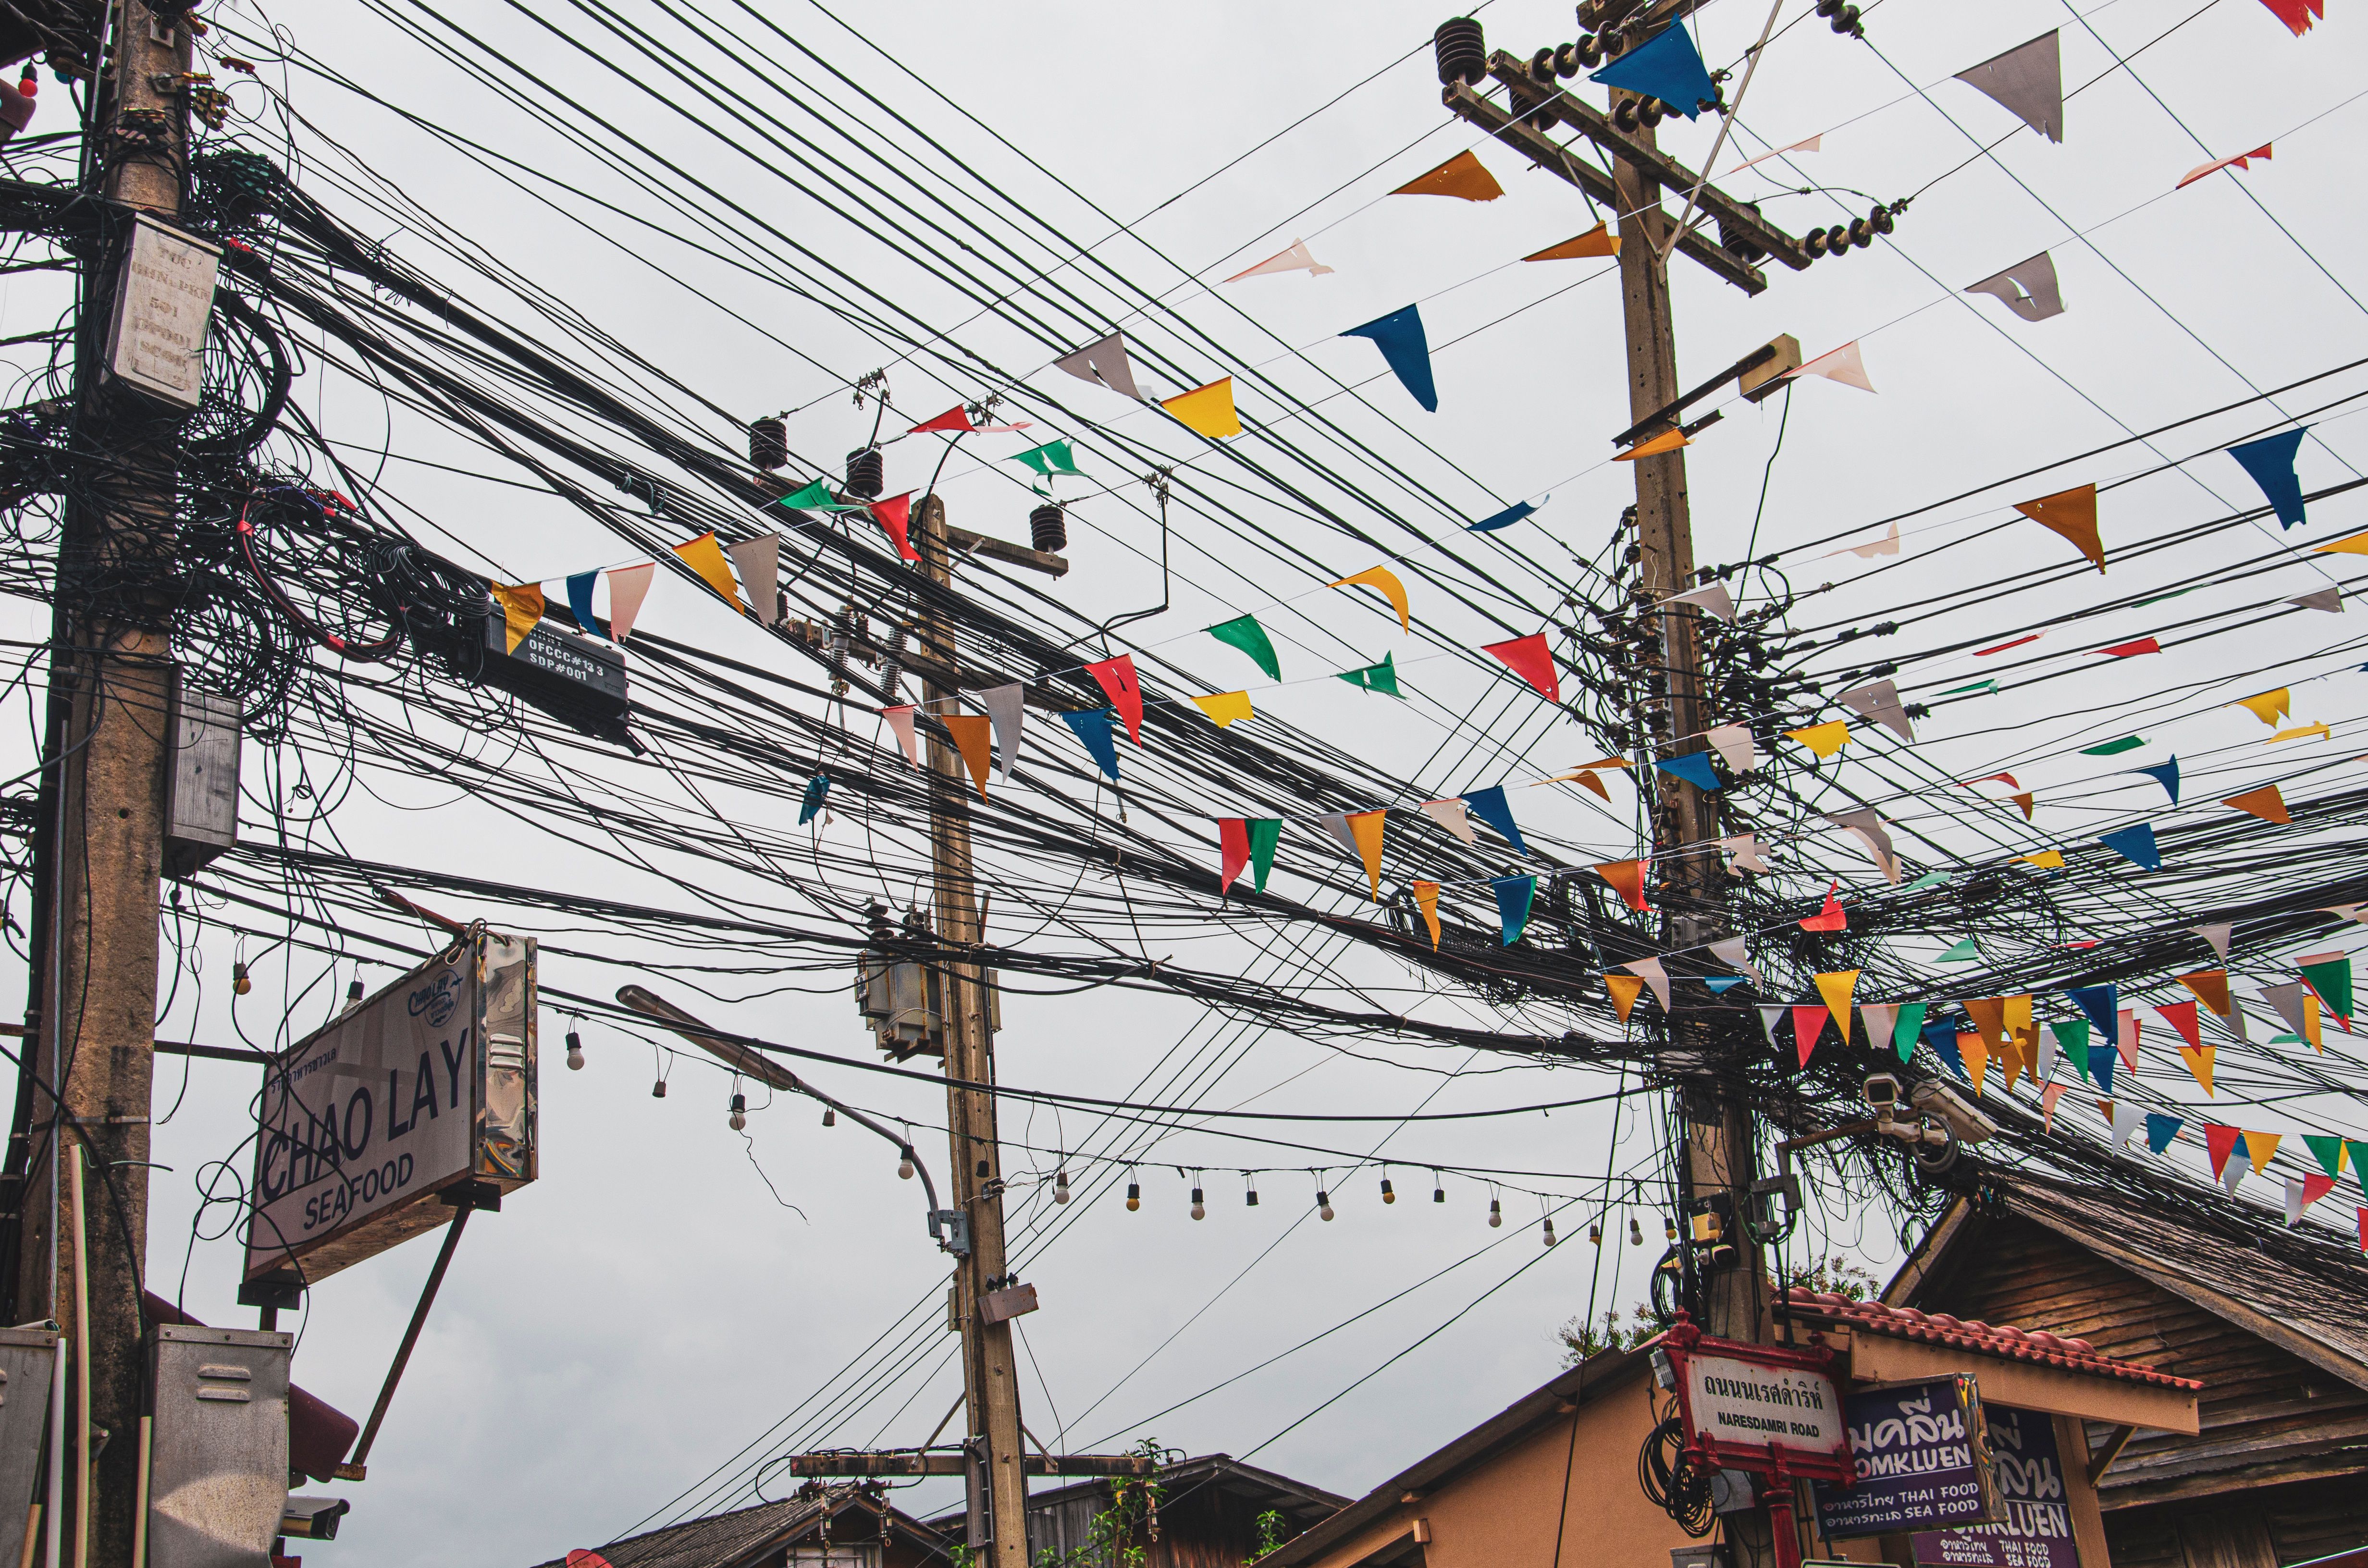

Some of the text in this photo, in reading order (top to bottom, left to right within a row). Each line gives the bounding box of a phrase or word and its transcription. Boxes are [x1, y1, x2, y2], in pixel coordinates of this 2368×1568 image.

[530, 652, 587, 681] SDP#001
[261, 1027, 469, 1201] CHAO LAY
[303, 1152, 414, 1230] SEAFOOD
[1704, 1375, 1823, 1410] ถนนนเรศดำริห์
[1717, 1411, 1820, 1438] NARESDAMRI ROAD
[1848, 1386, 1965, 1455] มคลื่น
[1854, 1443, 1972, 1479] OMKLUEN
[1823, 1482, 1979, 1512] อาหารไทย THAI FOOD
[1826, 1499, 1979, 1527] อาหารทะเล SEA FOOD
[1998, 1539, 2022, 1554] THAI
[2023, 1541, 2049, 1556] FOOD
[2005, 1553, 2025, 1567] SEA
[2026, 1555, 2051, 1568] FOOD
